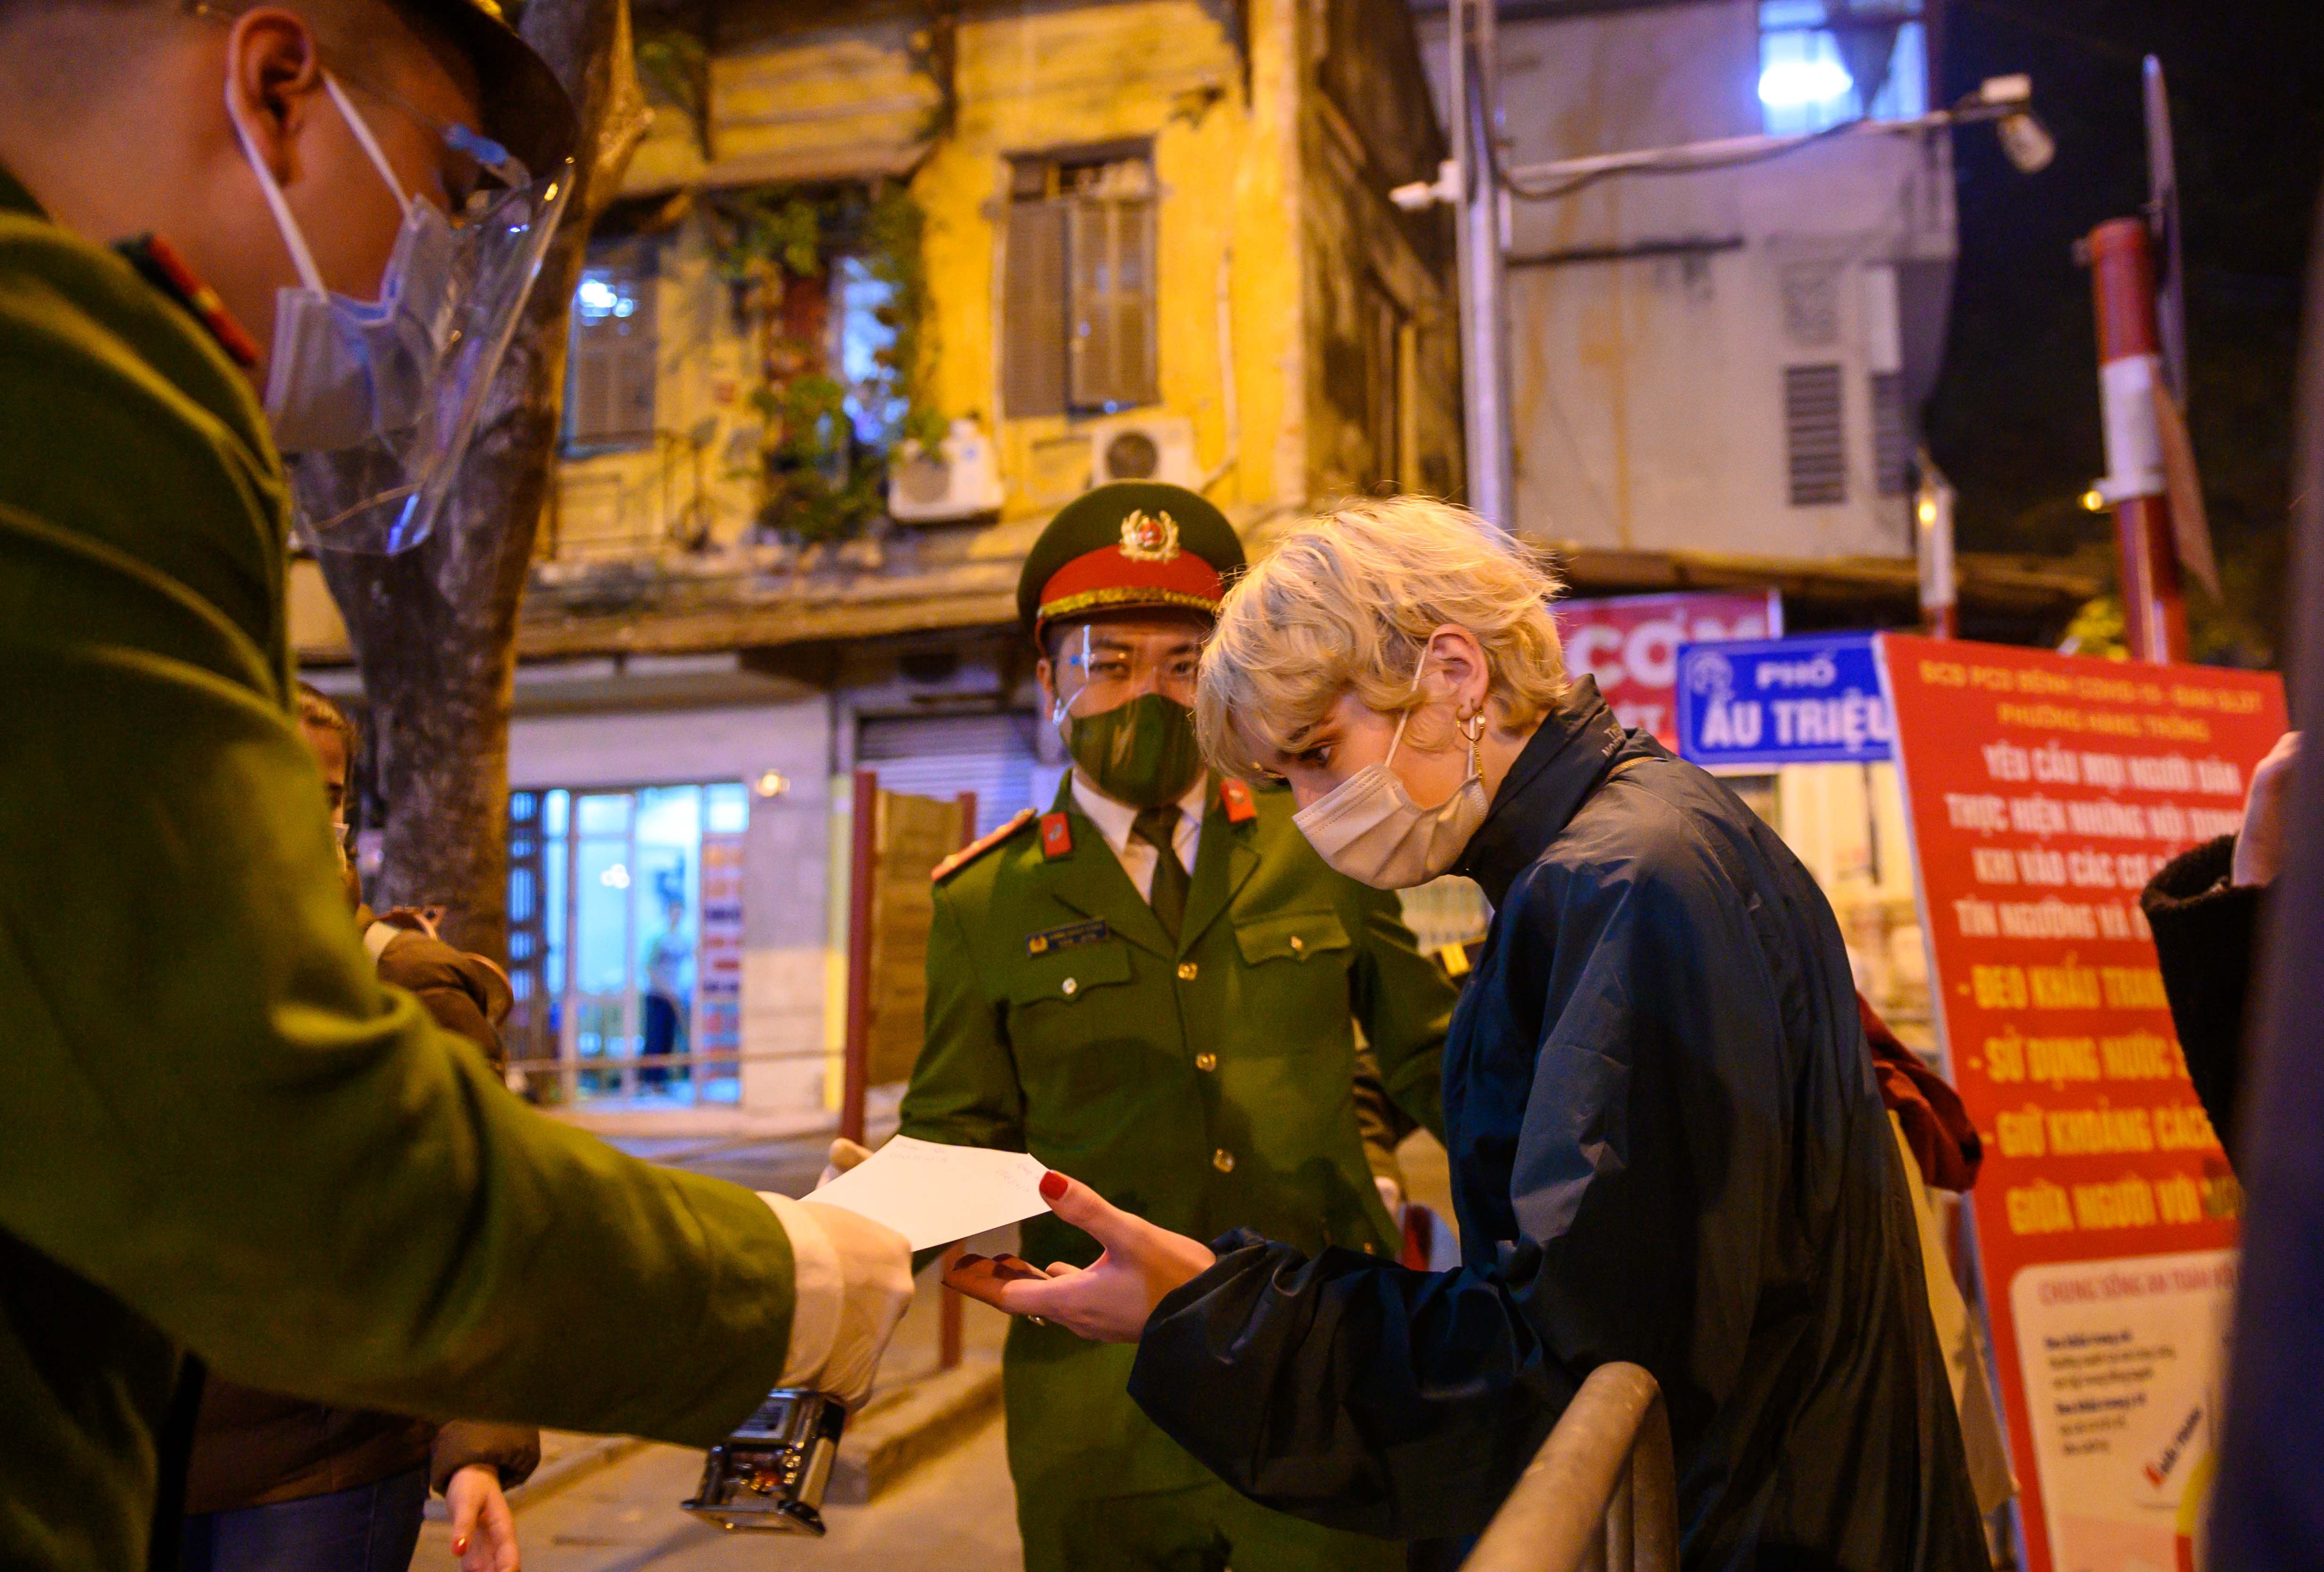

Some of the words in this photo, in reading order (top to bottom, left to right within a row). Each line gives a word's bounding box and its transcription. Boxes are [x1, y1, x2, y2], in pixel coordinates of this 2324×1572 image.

[1757, 649, 1835, 688] PHỐ
[1982, 740, 2030, 782] YÊU
[2032, 740, 2079, 785] CẦU
[2081, 751, 2122, 794] MỌI
[2129, 752, 2190, 792] NGƯỜI
[2196, 753, 2241, 796] DÂN
[1944, 793, 2008, 838] THỰC
[2009, 791, 2067, 841] HIỆN
[2067, 796, 2146, 839] NHỮNG
[1971, 847, 2018, 884] KHI
[2016, 844, 2067, 887] VÀO
[2068, 845, 2116, 887] CÁC
[1951, 893, 1999, 937] TÍN
[1998, 895, 2097, 939] NGƯỠNG
[2095, 898, 2131, 940] VÀ
[2030, 950, 2100, 1009] KHẨU
[1984, 1023, 2026, 1083] SỬ
[2026, 1036, 2101, 1092] DỤNG
[2099, 1027, 2173, 1081] NƯỚC
[1995, 1102, 2046, 1157] GIỮ
[2045, 1095, 2154, 1156] KHOẢNG
[2005, 1178, 2075, 1235] GIỮA
[2071, 1170, 2158, 1231] NGƯỜI
[2154, 1172, 2203, 1225] VỚI
